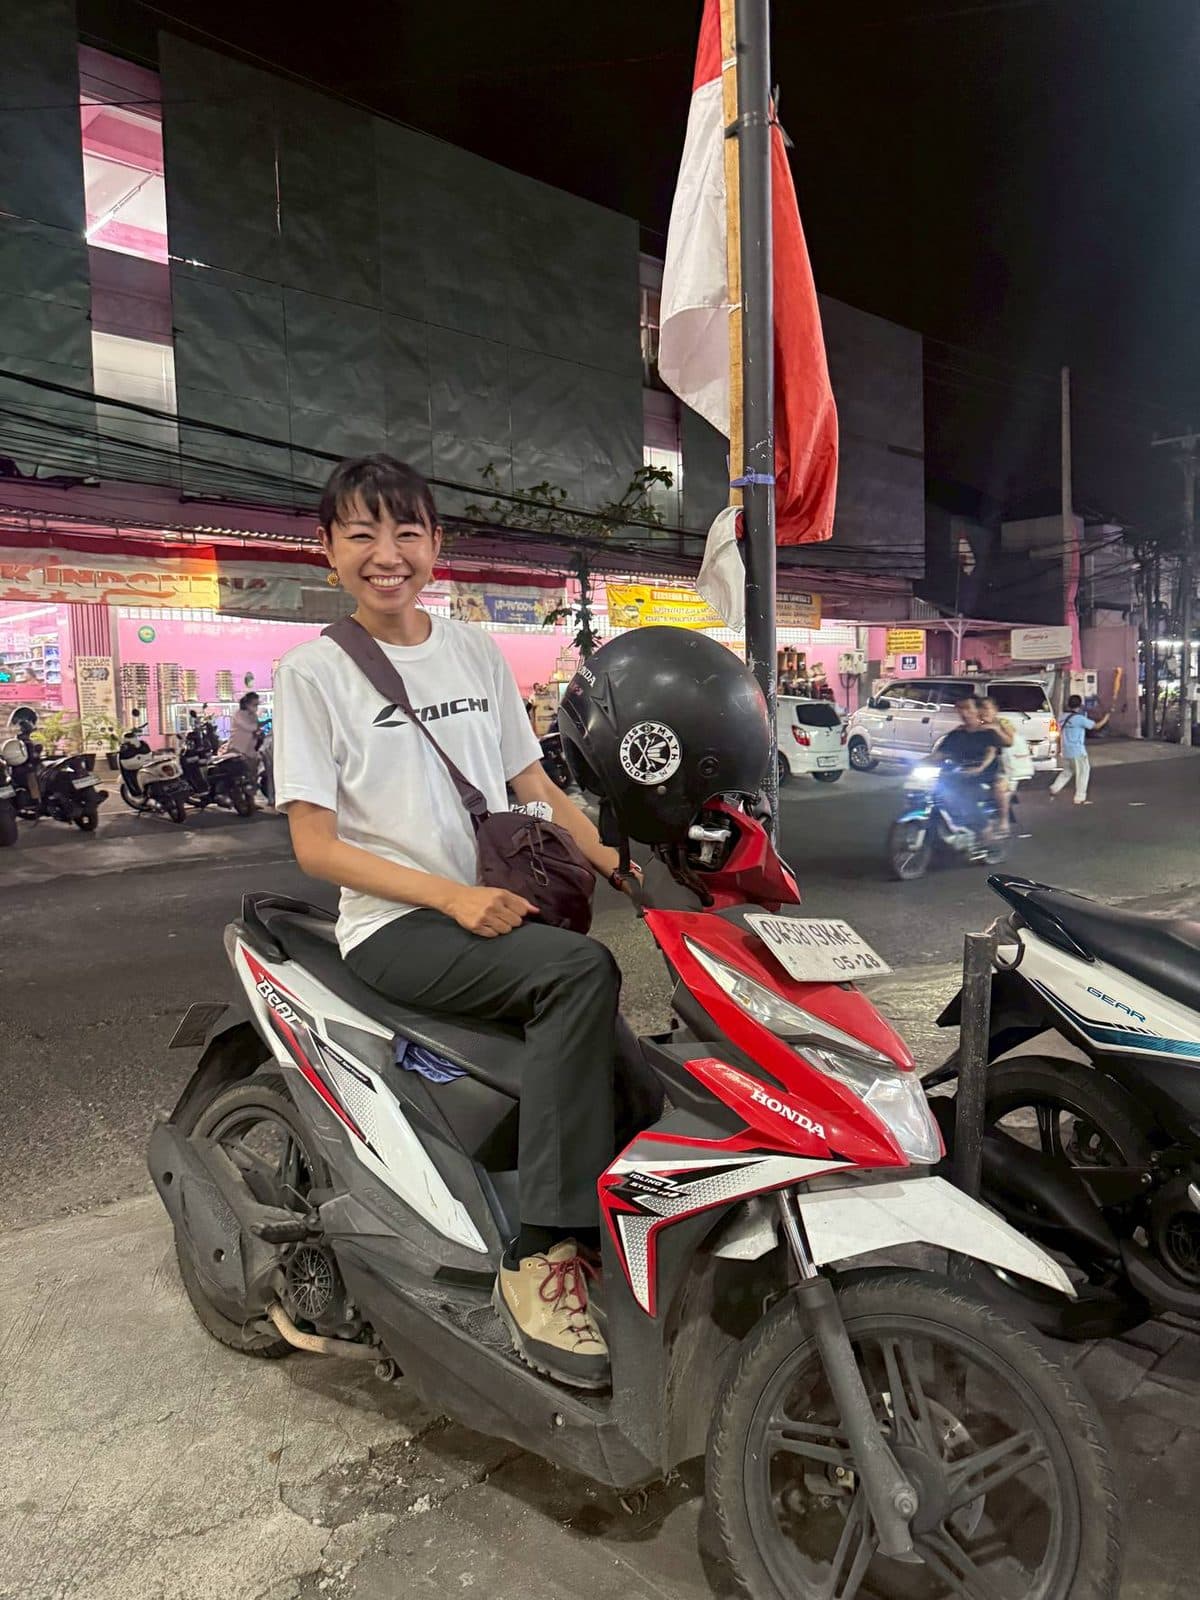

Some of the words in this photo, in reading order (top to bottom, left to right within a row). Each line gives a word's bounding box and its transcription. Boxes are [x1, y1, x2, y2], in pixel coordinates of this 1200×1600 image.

[1087, 986, 1146, 1022] GEAR
[750, 1089, 826, 1140] HONDA
[629, 1173, 663, 1186] IDLING
